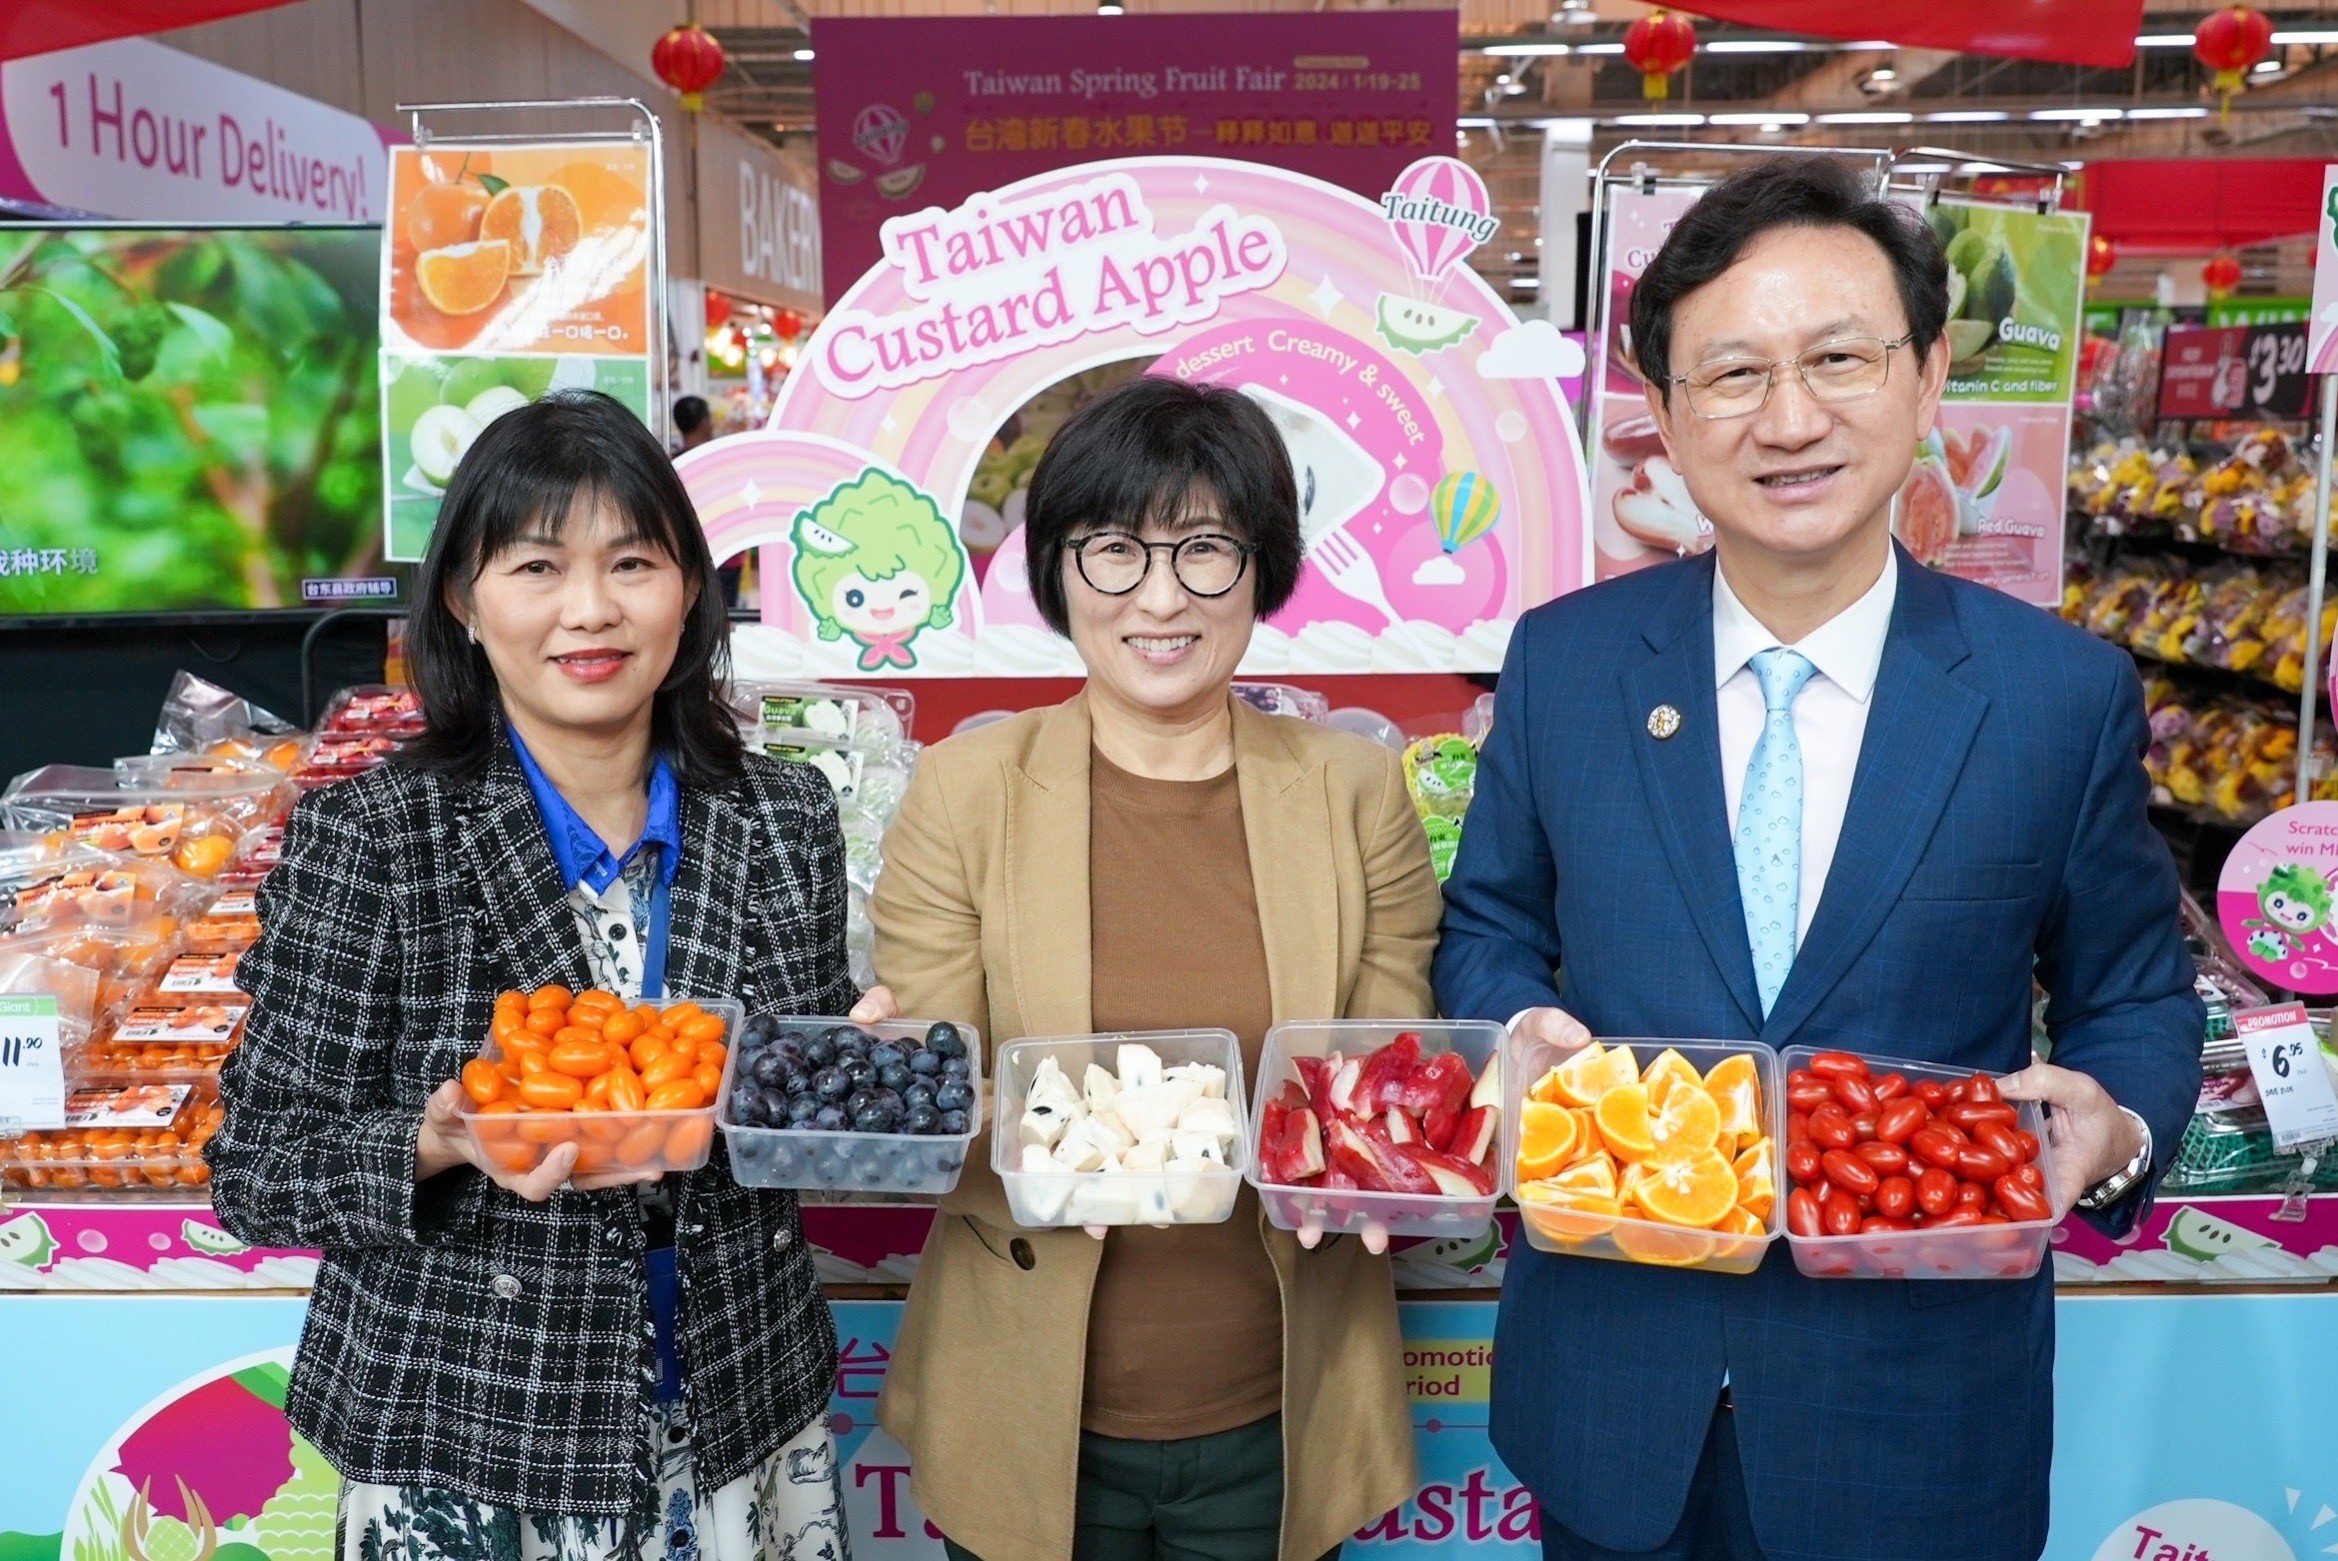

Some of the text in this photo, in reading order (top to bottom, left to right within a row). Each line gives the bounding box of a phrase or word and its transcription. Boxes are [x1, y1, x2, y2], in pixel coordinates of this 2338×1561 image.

[963, 70, 1062, 95] Taiwan
[1069, 67, 1159, 99] Spring
[1165, 65, 1227, 91] Fruit
[1236, 66, 1287, 91] Fair
[1294, 72, 1340, 90] 2024
[49, 72, 368, 221] 1 Hour Delivery!
[1384, 194, 1496, 242] Taitung
[896, 187, 1139, 285] Taiwan
[826, 219, 1273, 383] Custard Apple
[1998, 316, 2060, 351] Guava
[1175, 329, 1426, 446] dessert Creamy & sweet
[1945, 379, 2058, 393] itamin C and fiber
[1977, 517, 2047, 538] Red Guava
[2286, 842, 2338, 856] win M
[0, 1002, 31, 1013] Giant
[2247, 1010, 2297, 1029] PROMOTION
[1406, 1374, 1460, 1396] riod
